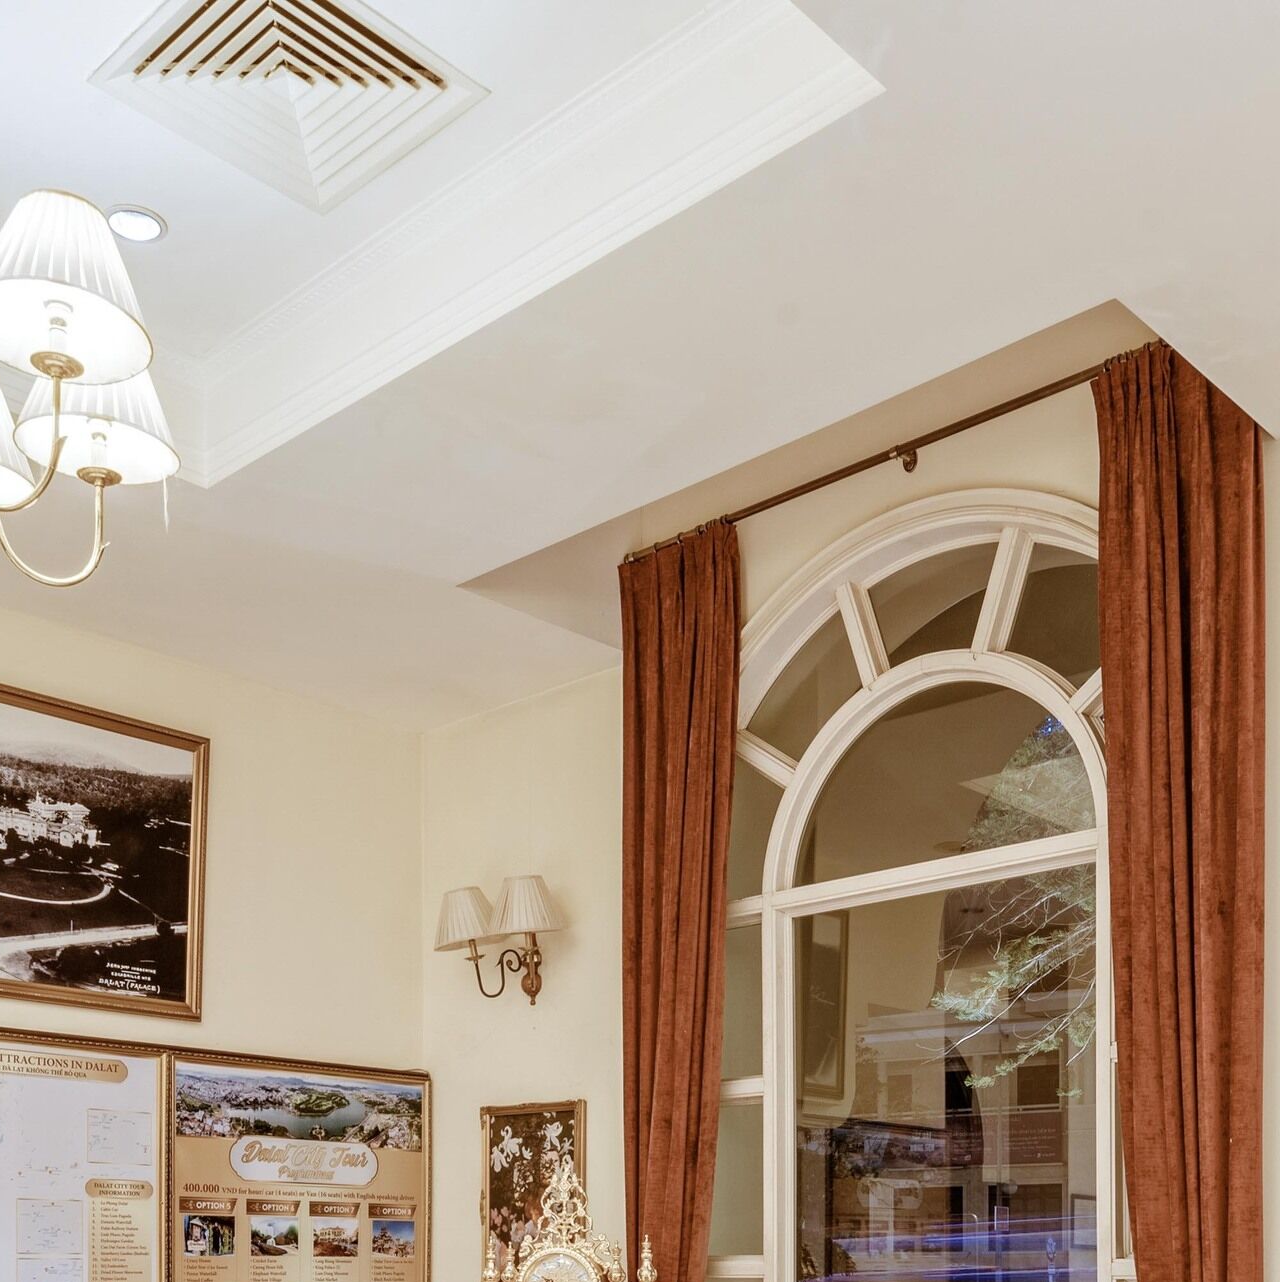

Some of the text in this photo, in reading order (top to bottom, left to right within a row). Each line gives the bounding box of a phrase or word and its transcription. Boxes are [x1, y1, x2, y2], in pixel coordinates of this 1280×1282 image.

[71, 1060, 82, 1069] IN
[86, 1062, 120, 1073] DALAT
[329, 1147, 368, 1168] Tour
[183, 1184, 219, 1193] 400.000
[196, 1202, 224, 1211] OPTION
[382, 1208, 406, 1217] OPTION
